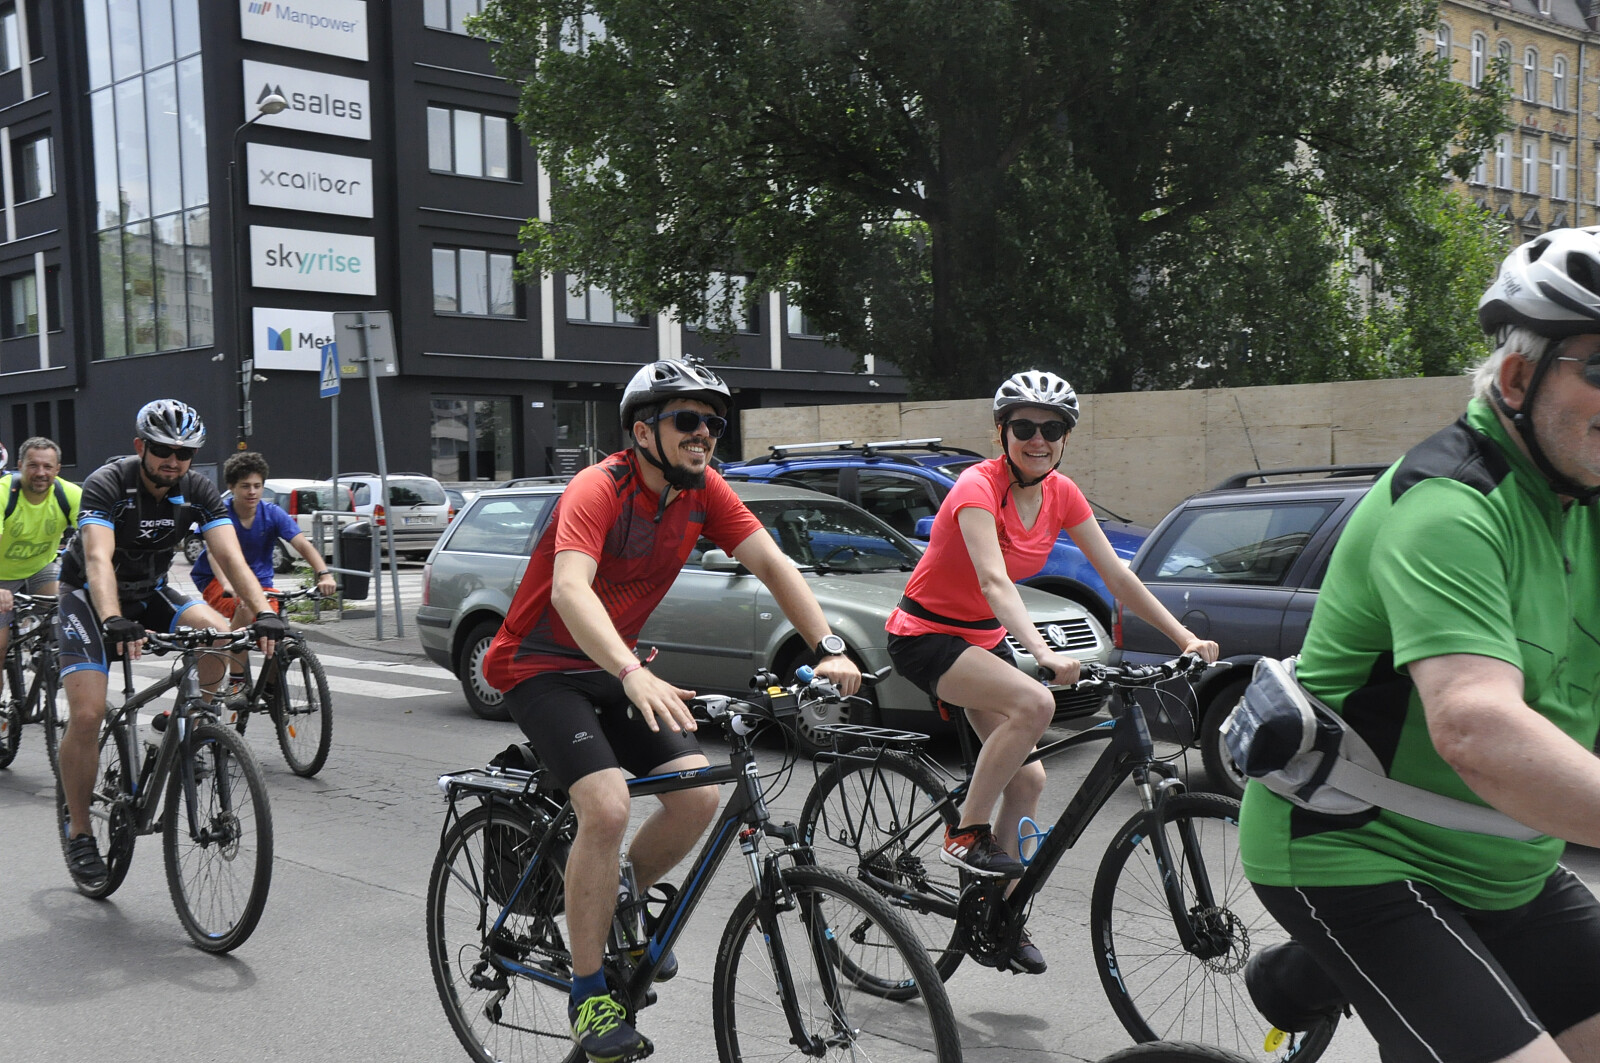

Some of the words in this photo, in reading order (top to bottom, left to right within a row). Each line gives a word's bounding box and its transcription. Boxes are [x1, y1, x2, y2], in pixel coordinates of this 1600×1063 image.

[275, 4, 357, 33] Manpower
[260, 168, 361, 195] xcaliber
[298, 332, 332, 349] Met
